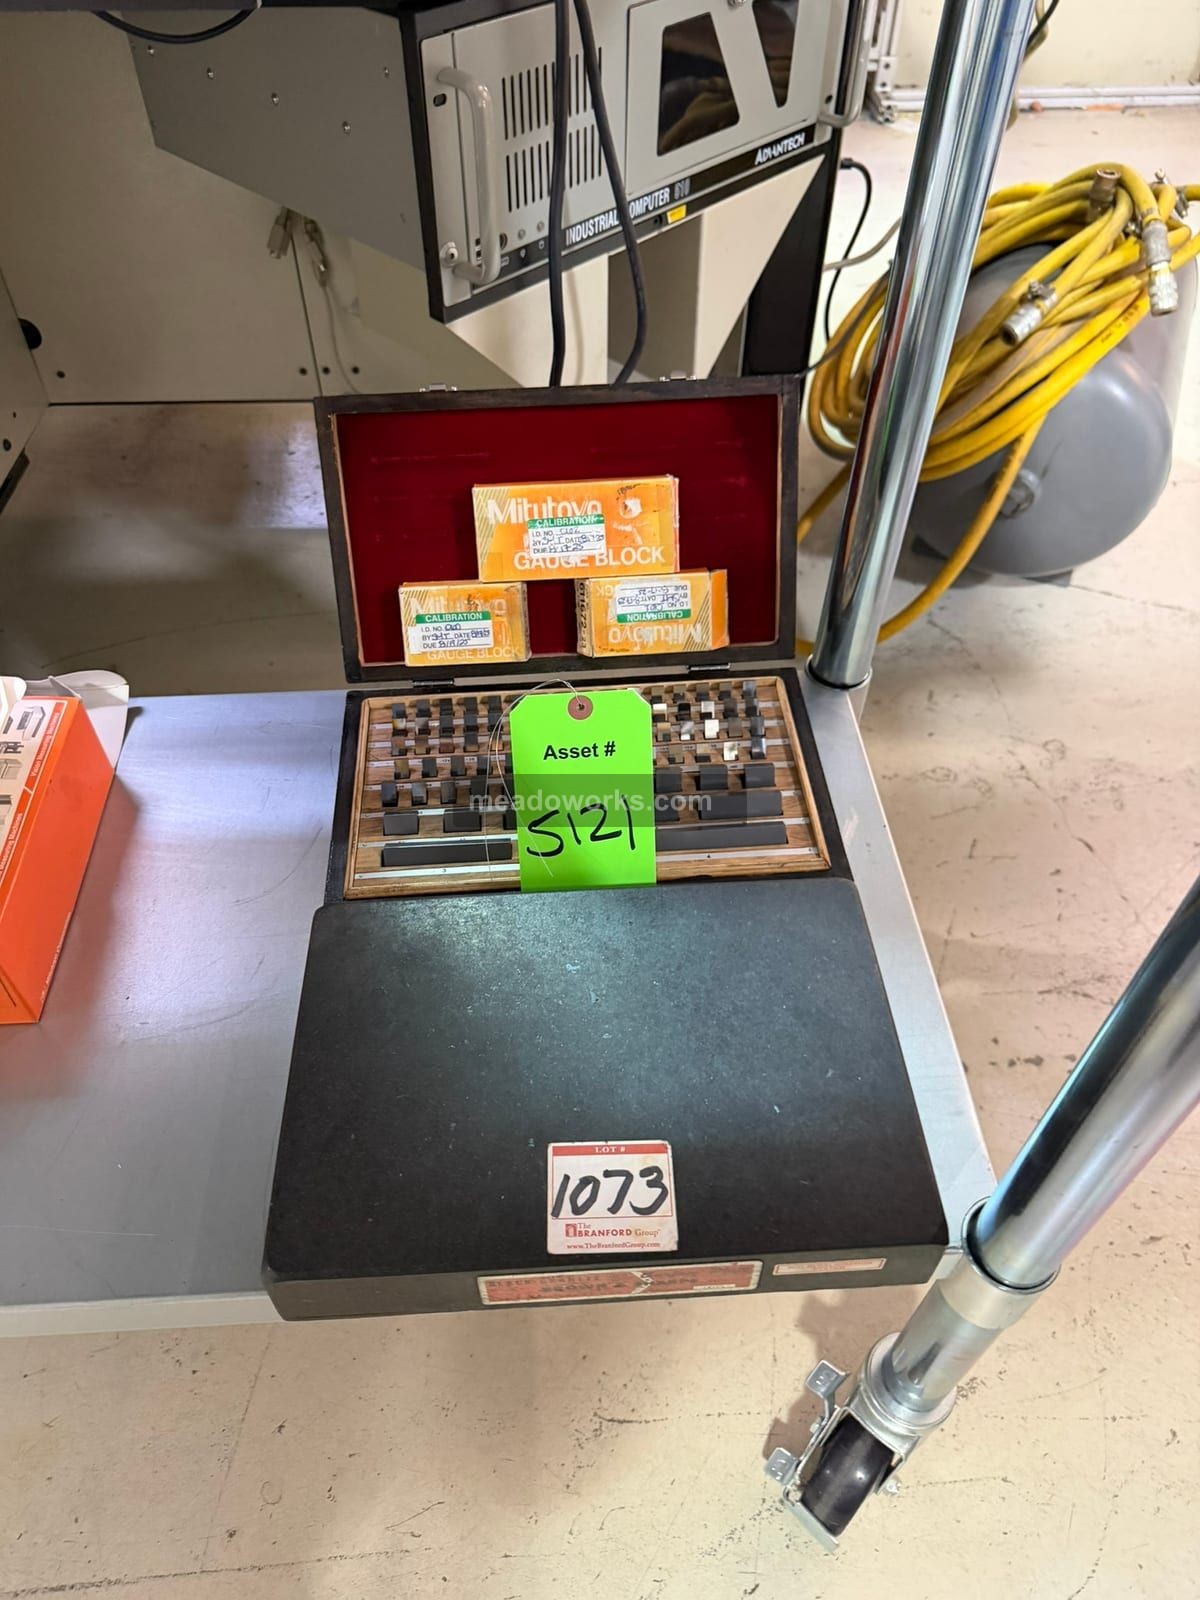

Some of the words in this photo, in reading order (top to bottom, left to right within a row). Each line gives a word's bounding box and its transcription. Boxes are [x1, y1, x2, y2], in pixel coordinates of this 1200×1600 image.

[566, 210, 620, 246] INDUSTRIAL
[629, 187, 670, 219] OMPUTER
[536, 515, 596, 529] CALIBRATION
[595, 546, 665, 566] BLOCK
[425, 612, 482, 623] CALIBRATION
[626, 610, 684, 621] CALIBRATION
[543, 744, 598, 760] Asset
[604, 741, 616, 757] #
[551, 1166, 668, 1218] 1073
[577, 1228, 632, 1237] BRANFORD
[635, 1229, 659, 1238] Group
[567, 1241, 660, 1250] www.TheBranfordGroup.com
